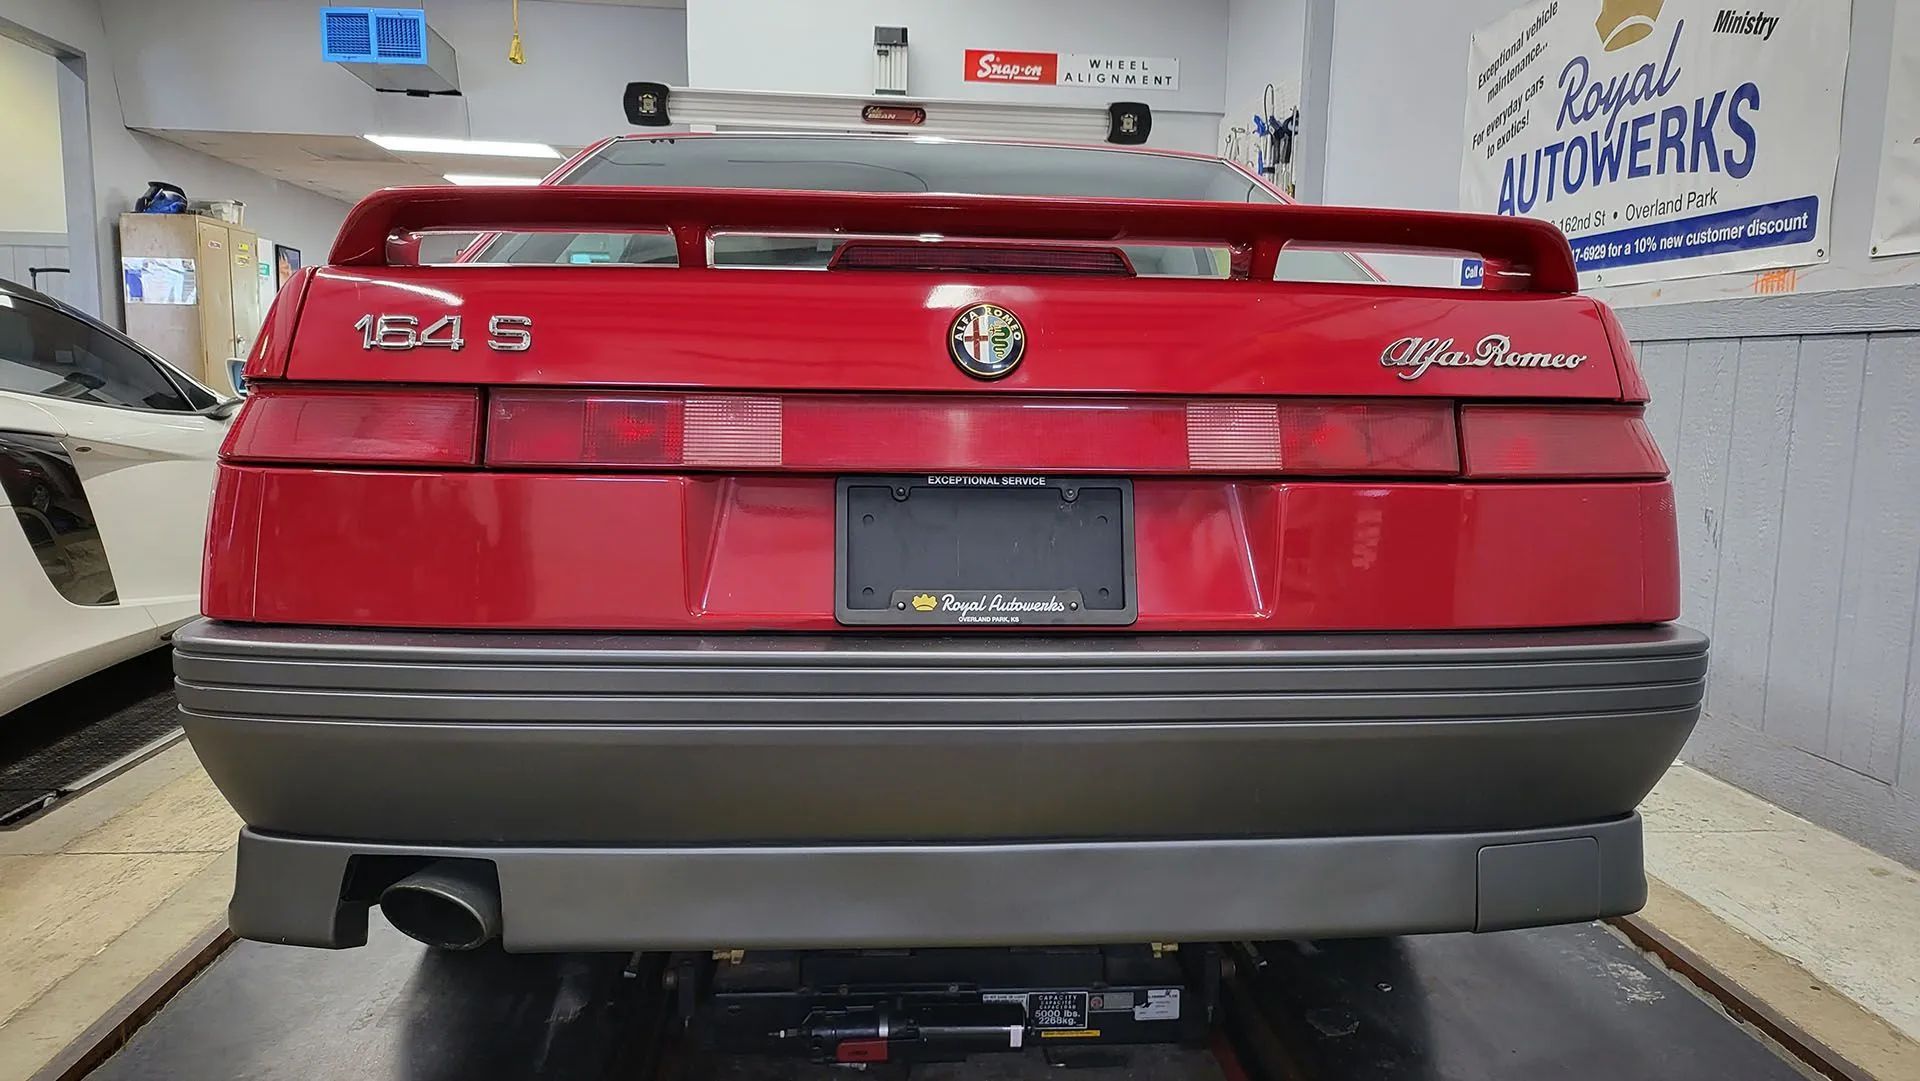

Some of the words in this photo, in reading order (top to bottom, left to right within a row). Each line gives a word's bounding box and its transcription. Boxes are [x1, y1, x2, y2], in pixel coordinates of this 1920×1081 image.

[1713, 10, 1779, 40] Ministry
[1478, 31, 1524, 90] Exceptional
[1526, 1, 1558, 41] vehicle
[1064, 73, 1172, 86] ALIGNMENT
[1089, 59, 1148, 70] WHEEL
[1556, 19, 1685, 141] Royal
[1472, 129, 1484, 150] For
[1486, 94, 1523, 137] everyday
[1525, 75, 1544, 101] cars
[1487, 144, 1495, 159] to
[1496, 109, 1530, 150] exotics!
[1498, 82, 1760, 215] AUTOWERKS
[1559, 212, 1591, 234] 162nd
[1594, 209, 1606, 228] St
[1625, 193, 1683, 221] Overland
[1686, 187, 1718, 210] Park
[1607, 242, 1622, 259] for
[1624, 244, 1631, 255] a
[1634, 235, 1657, 255] 10%
[1660, 235, 1683, 250] new
[1686, 224, 1745, 246] customer
[1747, 211, 1809, 237] discount
[1465, 264, 1479, 280] Call
[354, 313, 465, 350] 164
[487, 314, 533, 351] S
[955, 310, 979, 341] ALFA
[984, 306, 1022, 341] ROMEO
[1380, 336, 1474, 381] Alfa
[1473, 333, 1588, 370] Romeo
[927, 476, 1000, 486] EXCEPTIONAL
[1002, 477, 1046, 486] SERVICE
[941, 593, 987, 618] Royal
[988, 593, 1065, 612] Autowerks
[1034, 1009, 1061, 1018] 5000
[1063, 1009, 1081, 1018] lbs.
[1038, 1016, 1077, 1026] 2268kg.
